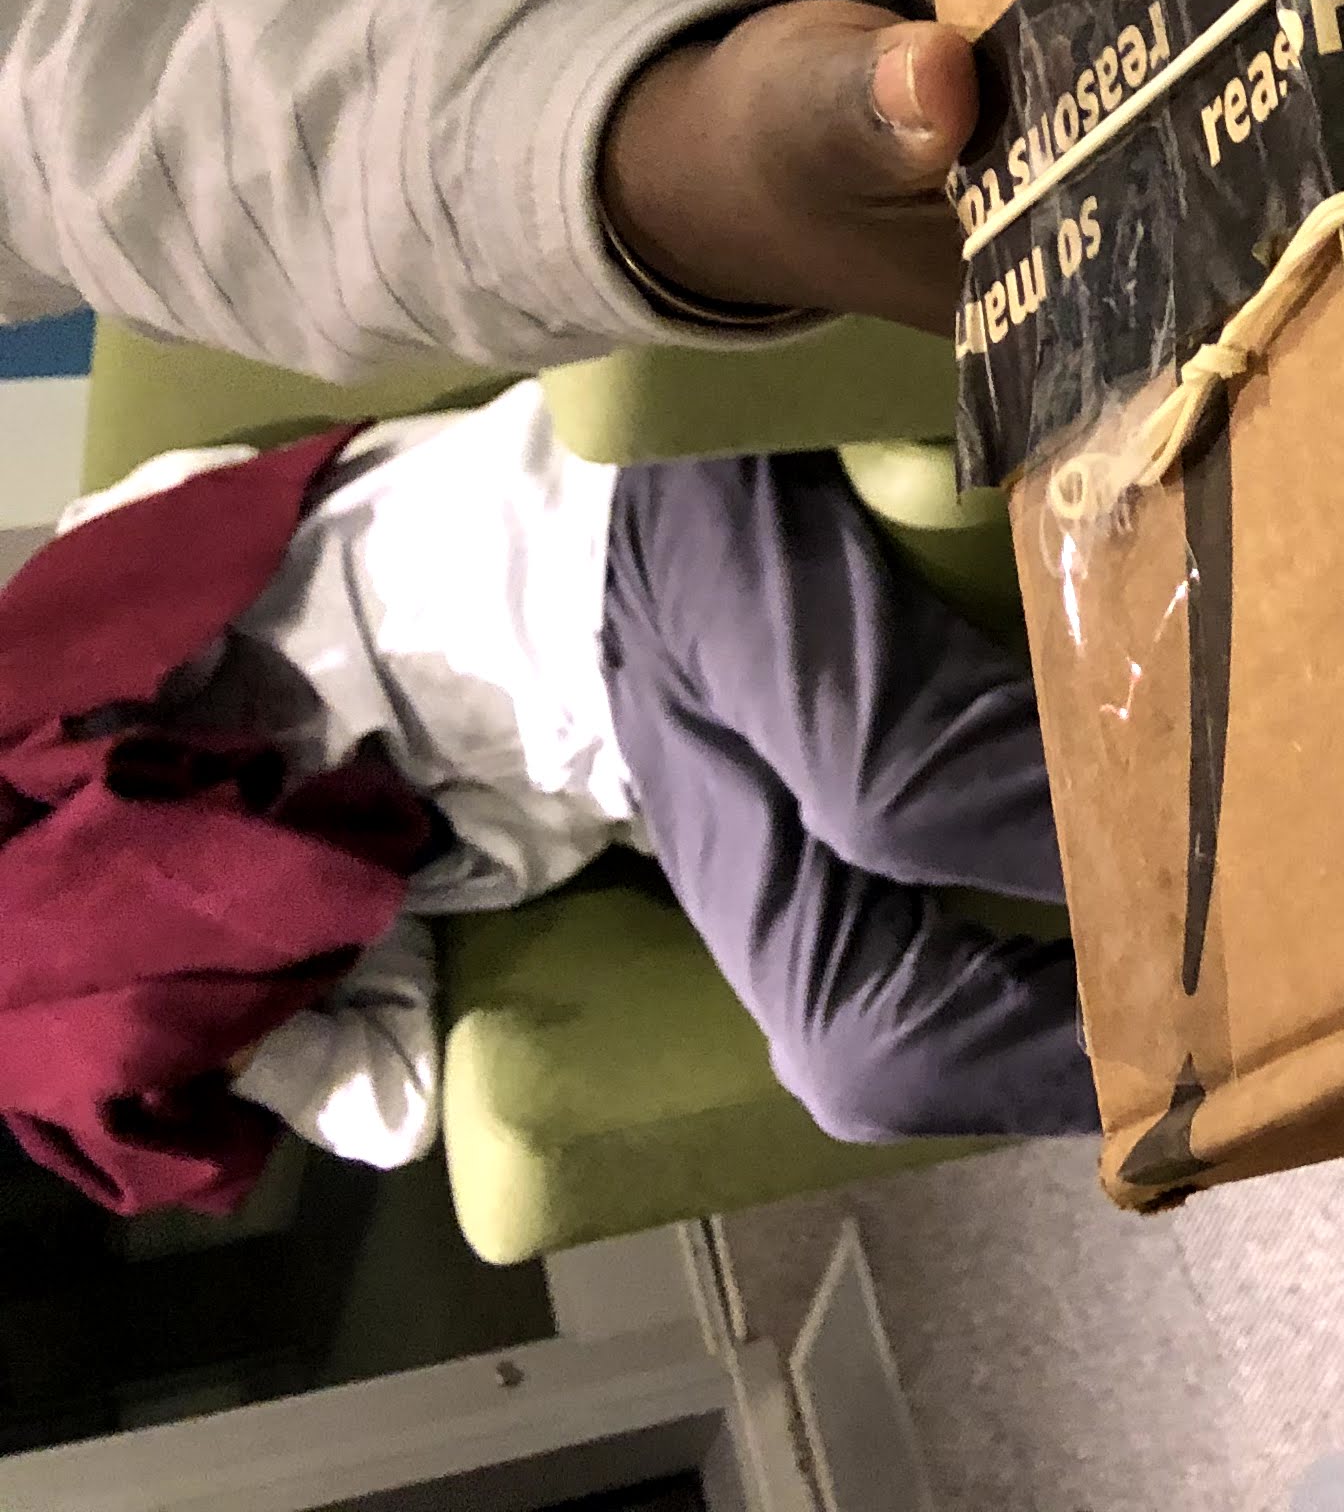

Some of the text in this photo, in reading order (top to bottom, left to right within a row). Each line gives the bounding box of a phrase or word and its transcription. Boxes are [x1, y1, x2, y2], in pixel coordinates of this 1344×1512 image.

[1008, 0, 1171, 198] reasons
[955, 194, 1102, 361] so man
